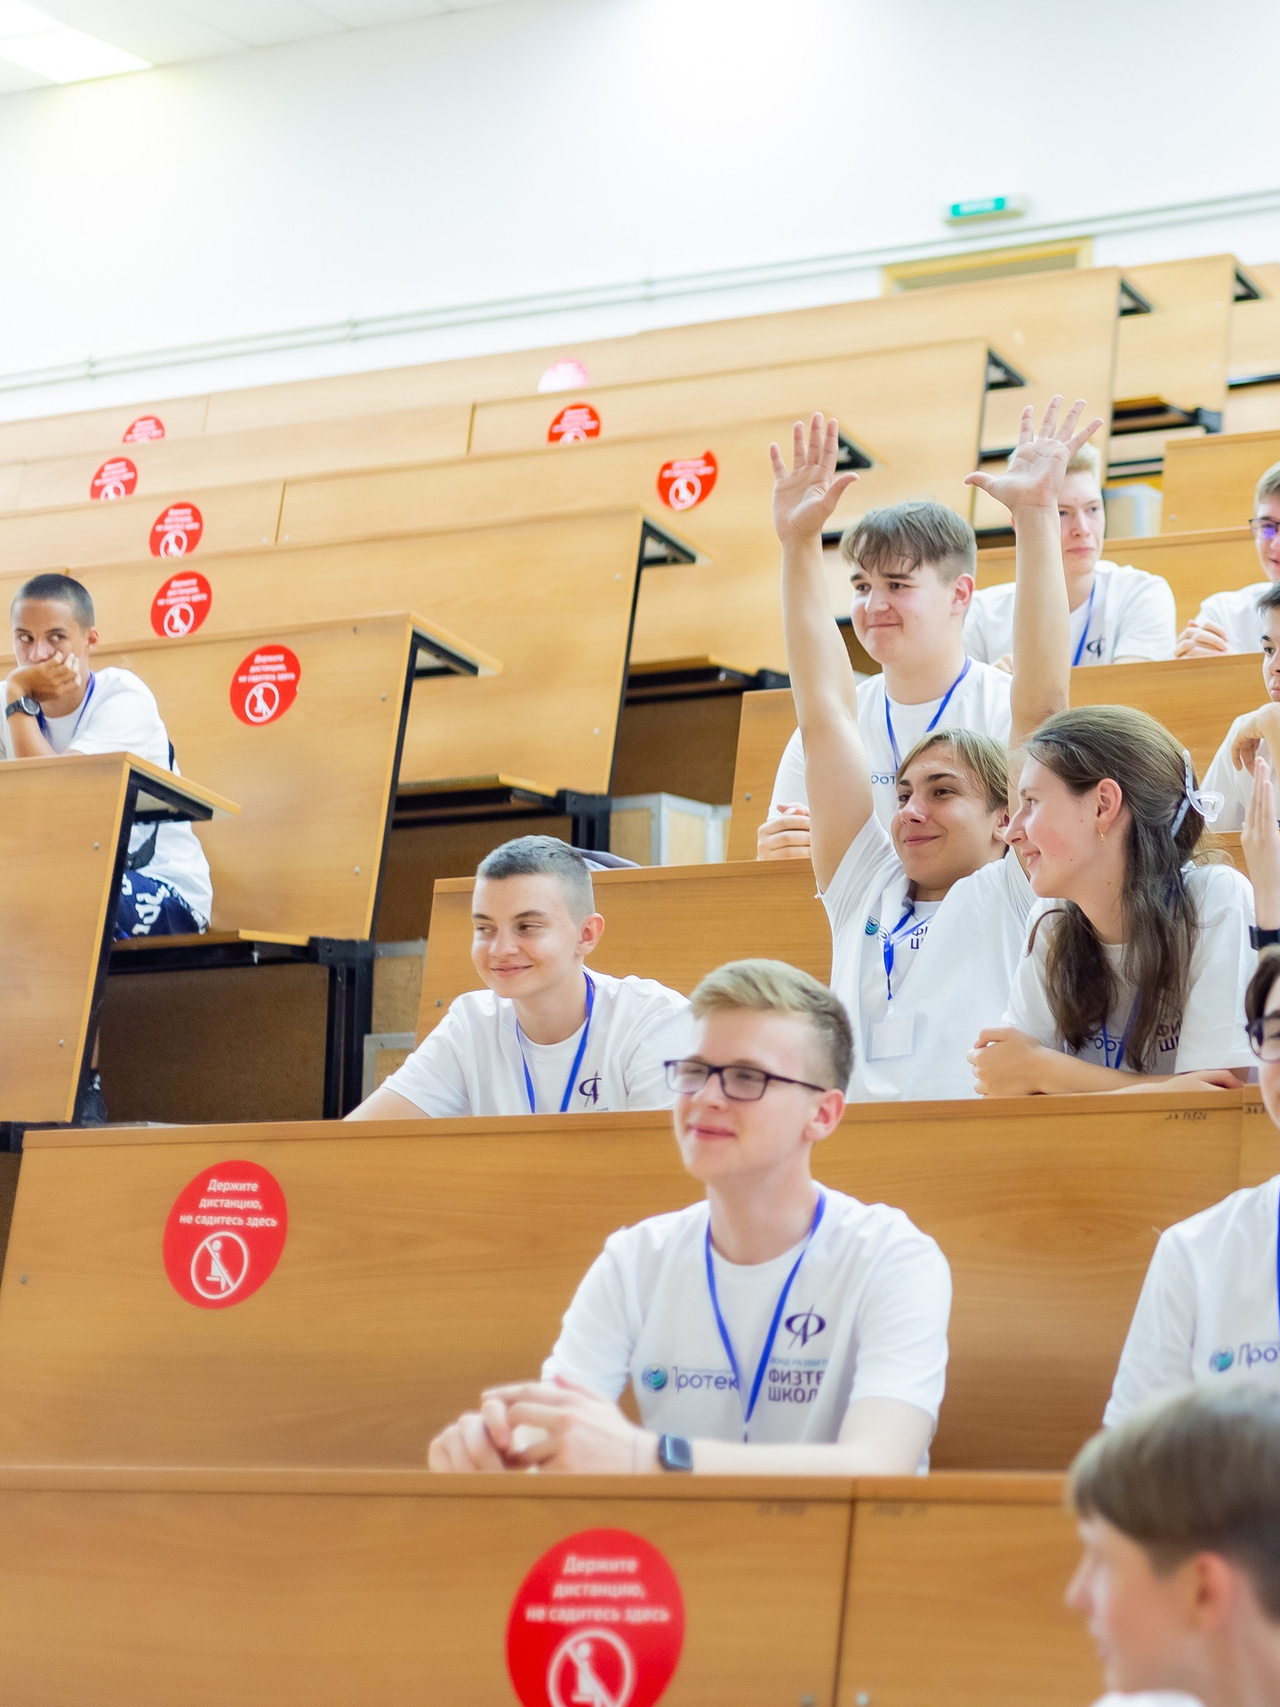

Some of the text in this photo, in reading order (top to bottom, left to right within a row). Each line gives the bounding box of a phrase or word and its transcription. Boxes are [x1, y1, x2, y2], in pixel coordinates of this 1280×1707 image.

[207, 1178, 259, 1193] Держите
[199, 1198, 262, 1210] дистанцию,
[179, 1215, 277, 1227] не садитесь здесь
[769, 1368, 825, 1385] ФИЗТЕ
